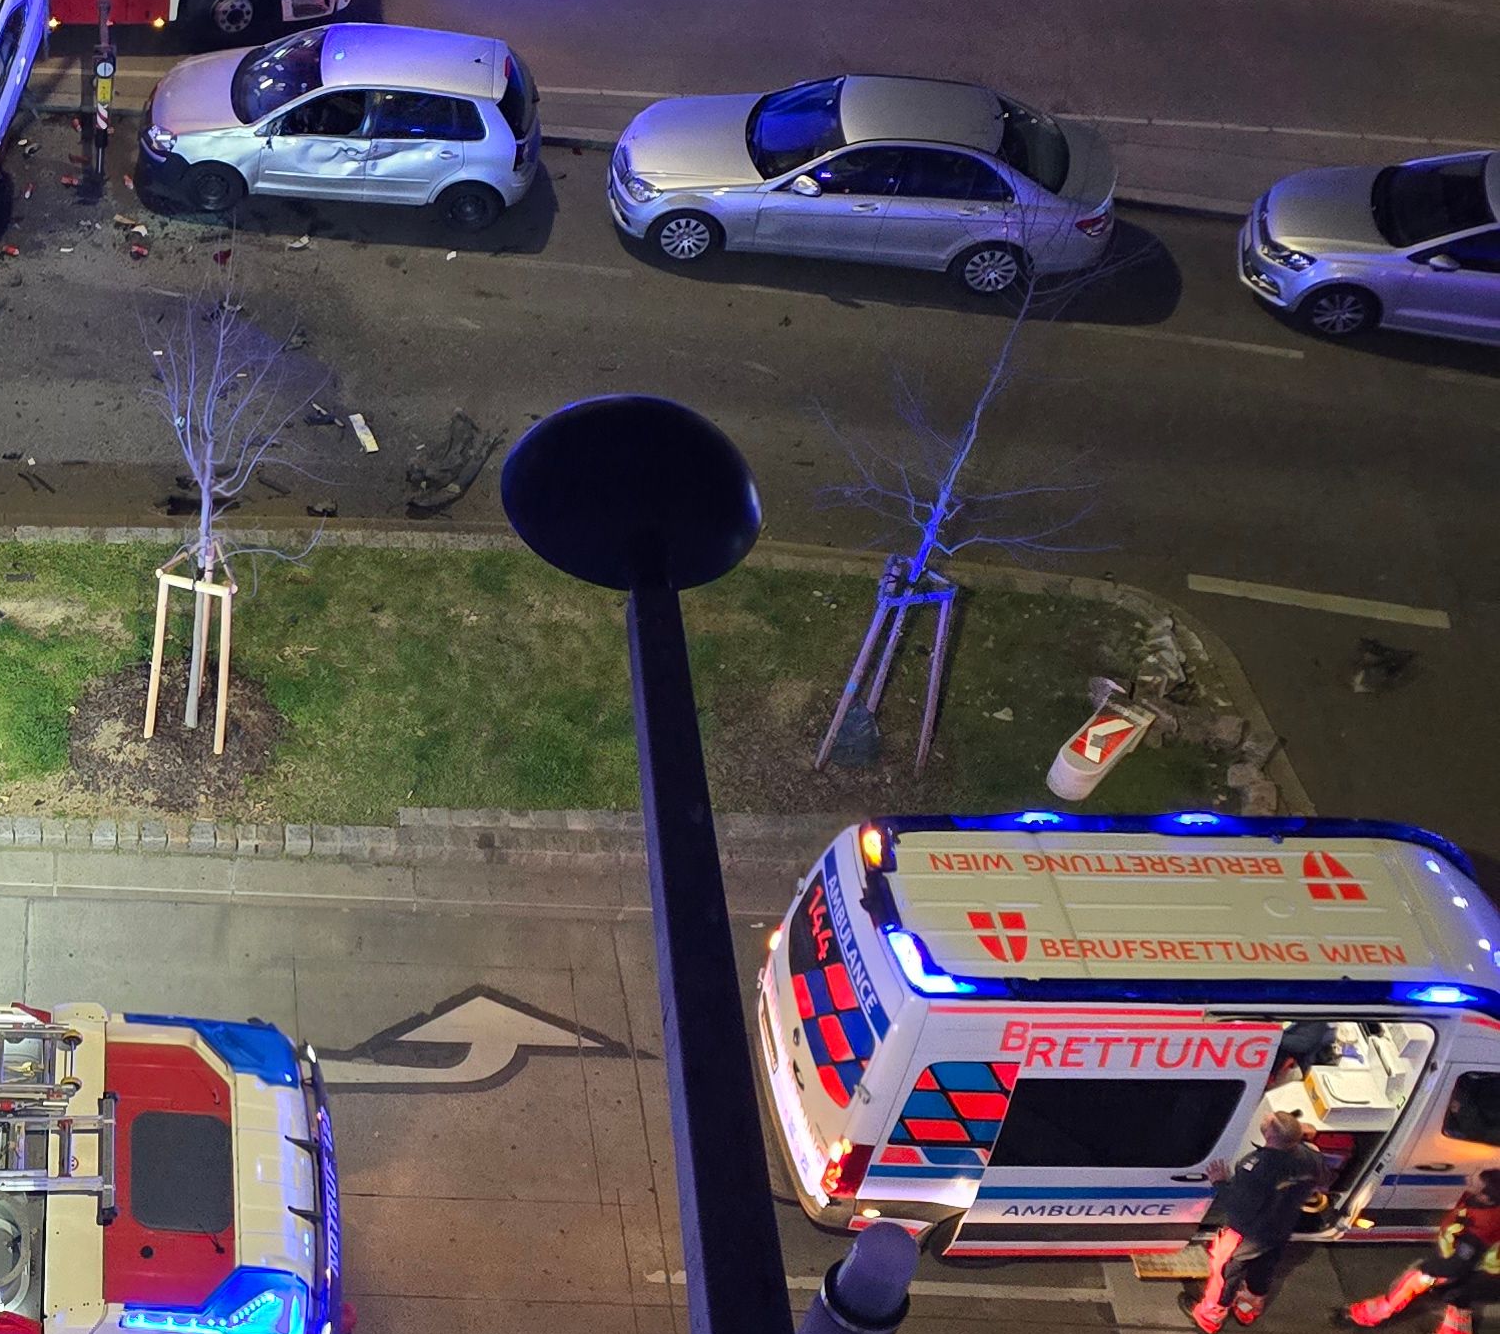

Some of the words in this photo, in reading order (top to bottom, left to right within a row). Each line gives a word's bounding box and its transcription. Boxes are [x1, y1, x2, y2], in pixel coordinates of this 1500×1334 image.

[928, 851, 1013, 873] WIEN
[1022, 852, 1286, 877] BERUFSRETTUNG
[808, 884, 833, 962] 144
[827, 874, 879, 1015] AMBULANCE
[1040, 938, 1309, 964] BERUFSRETTUNG
[1318, 943, 1407, 965] WIEN
[324, 1156, 339, 1279] NOTRUF
[1000, 1202, 1173, 1218] AMBULANCE
